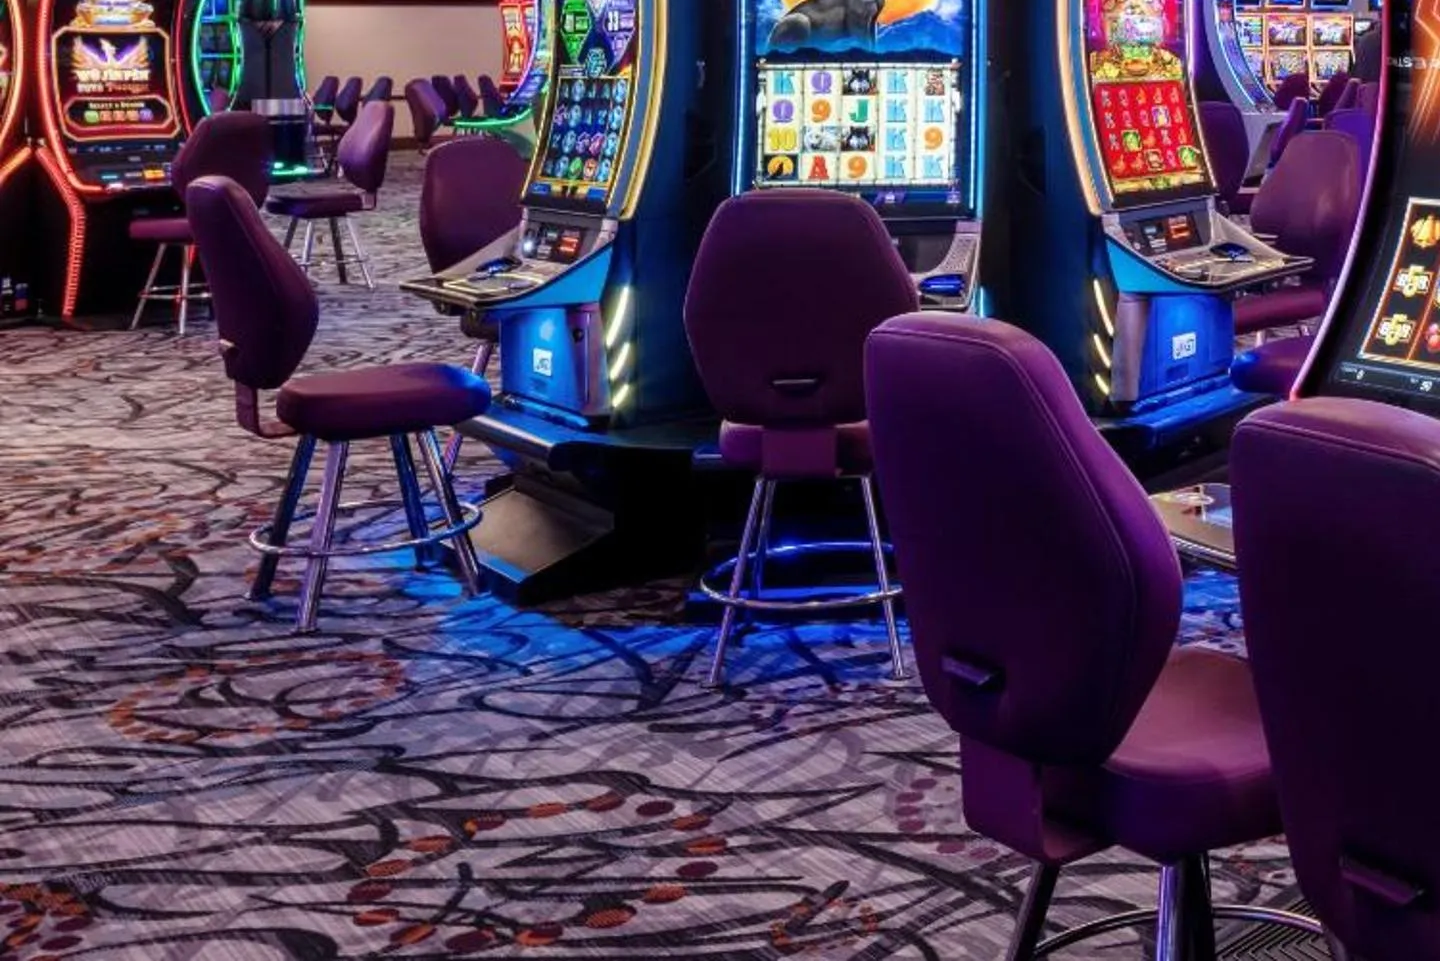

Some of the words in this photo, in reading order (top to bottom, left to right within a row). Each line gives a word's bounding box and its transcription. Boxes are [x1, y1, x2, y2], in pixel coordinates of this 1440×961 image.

[774, 71, 795, 95] K
[811, 71, 832, 95] Q
[886, 71, 907, 95] K
[772, 98, 795, 123] Q
[811, 98, 832, 123] 9
[849, 98, 869, 123] J
[886, 98, 907, 123] K
[923, 98, 945, 123] K
[768, 126, 798, 151] 10
[886, 127, 907, 151] K
[923, 126, 944, 150] 9
[807, 155, 830, 180] A
[847, 154, 868, 179] 9
[885, 155, 907, 179] K
[923, 155, 945, 179] K
